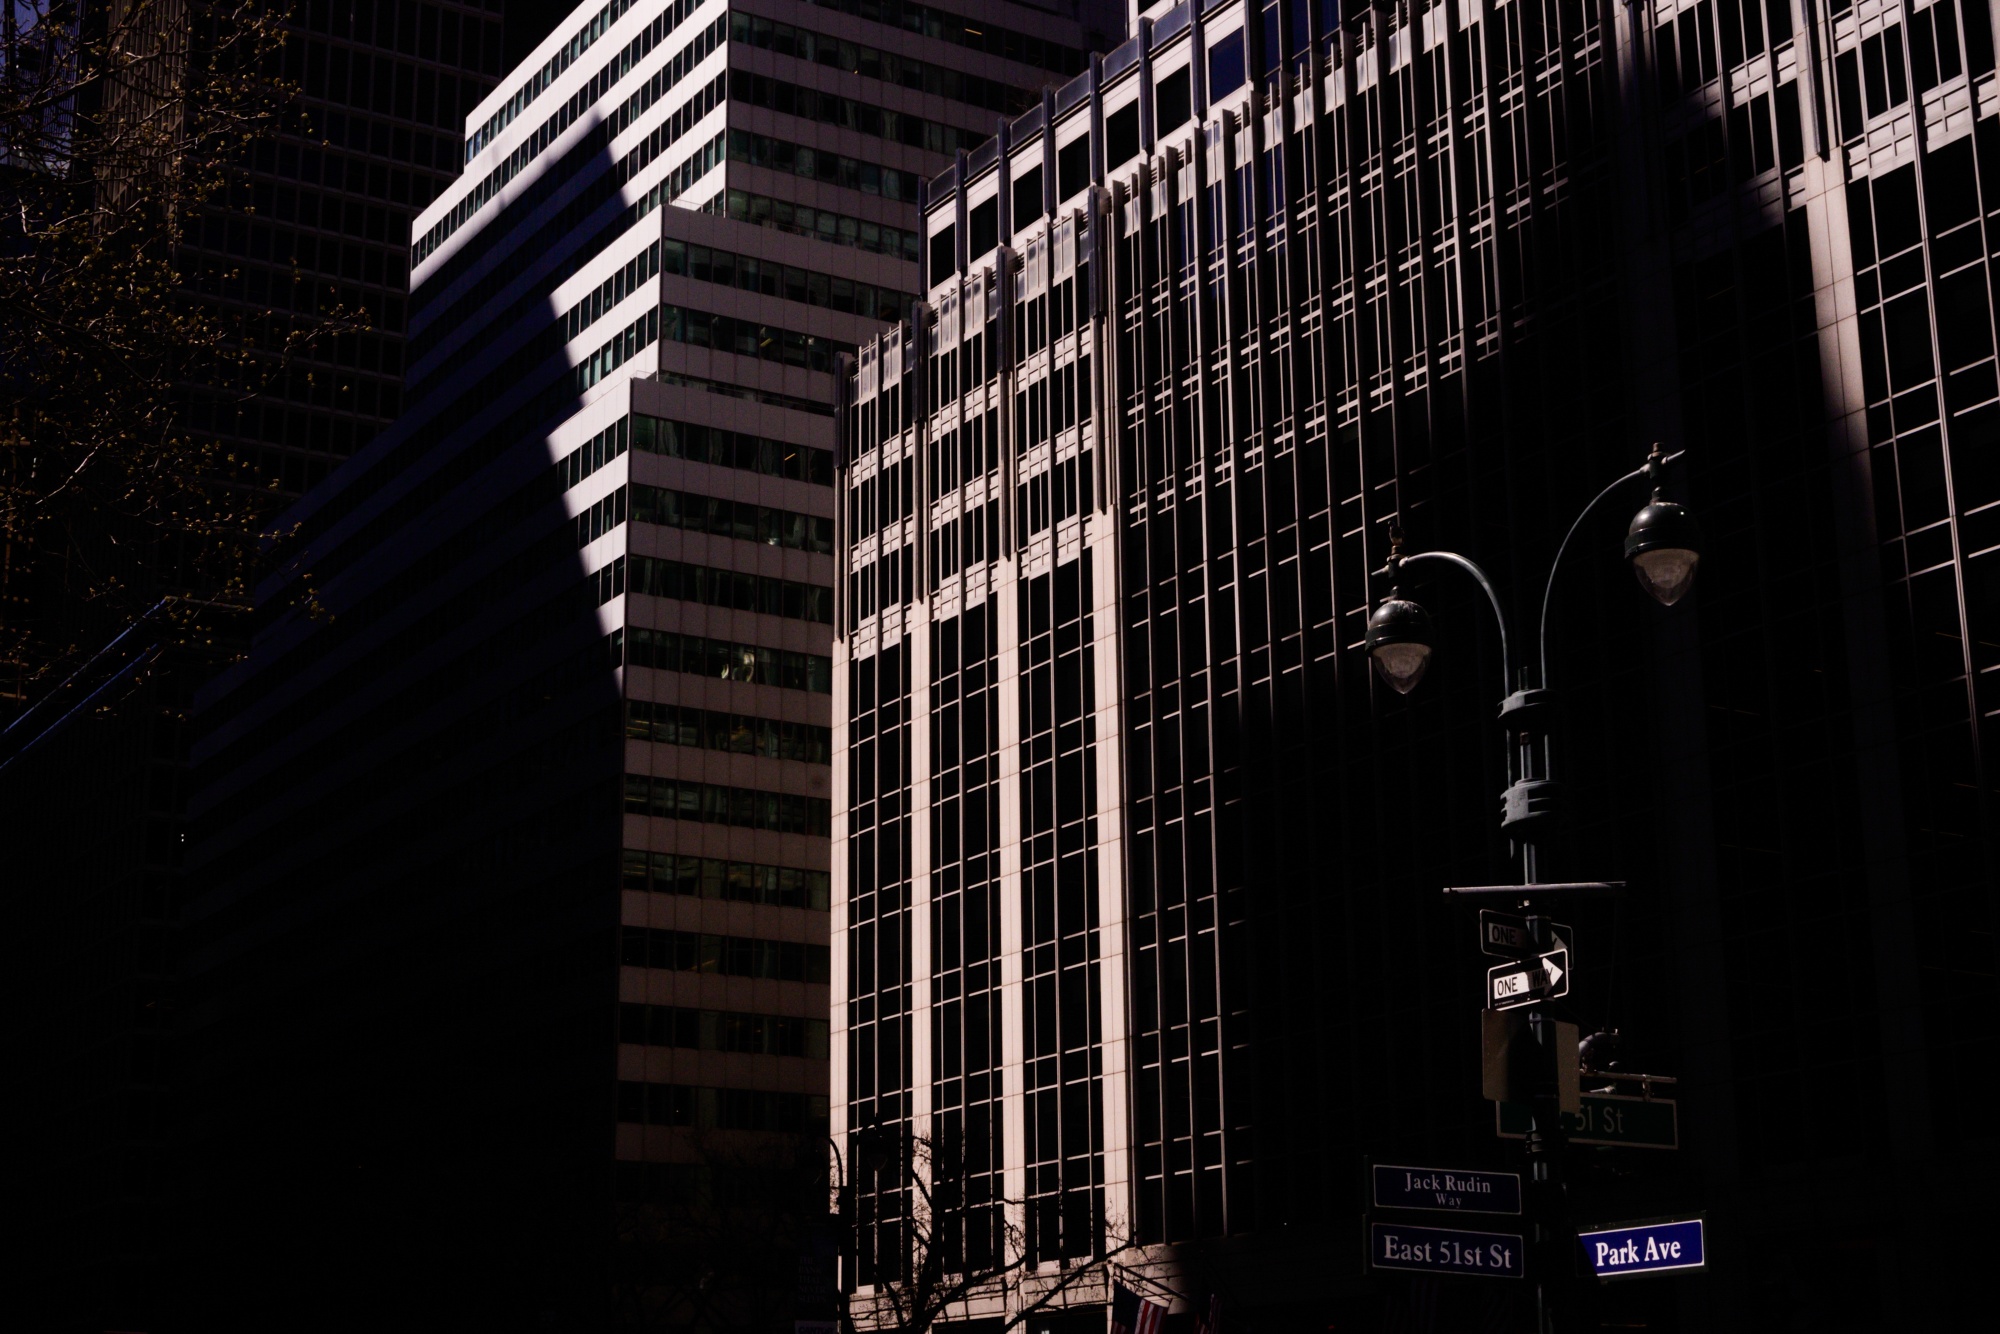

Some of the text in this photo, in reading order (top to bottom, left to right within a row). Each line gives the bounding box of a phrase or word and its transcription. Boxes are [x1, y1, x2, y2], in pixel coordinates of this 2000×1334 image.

[1492, 926, 1517, 945] ONE
[1497, 967, 1554, 996] ONE WAY
[1602, 1106, 1625, 1134] St
[1404, 1172, 1492, 1194] Jack Rudin
[1436, 1192, 1462, 1208] Way
[1383, 1235, 1513, 1269] East 51st St
[1595, 1236, 1682, 1267] Park Ave
